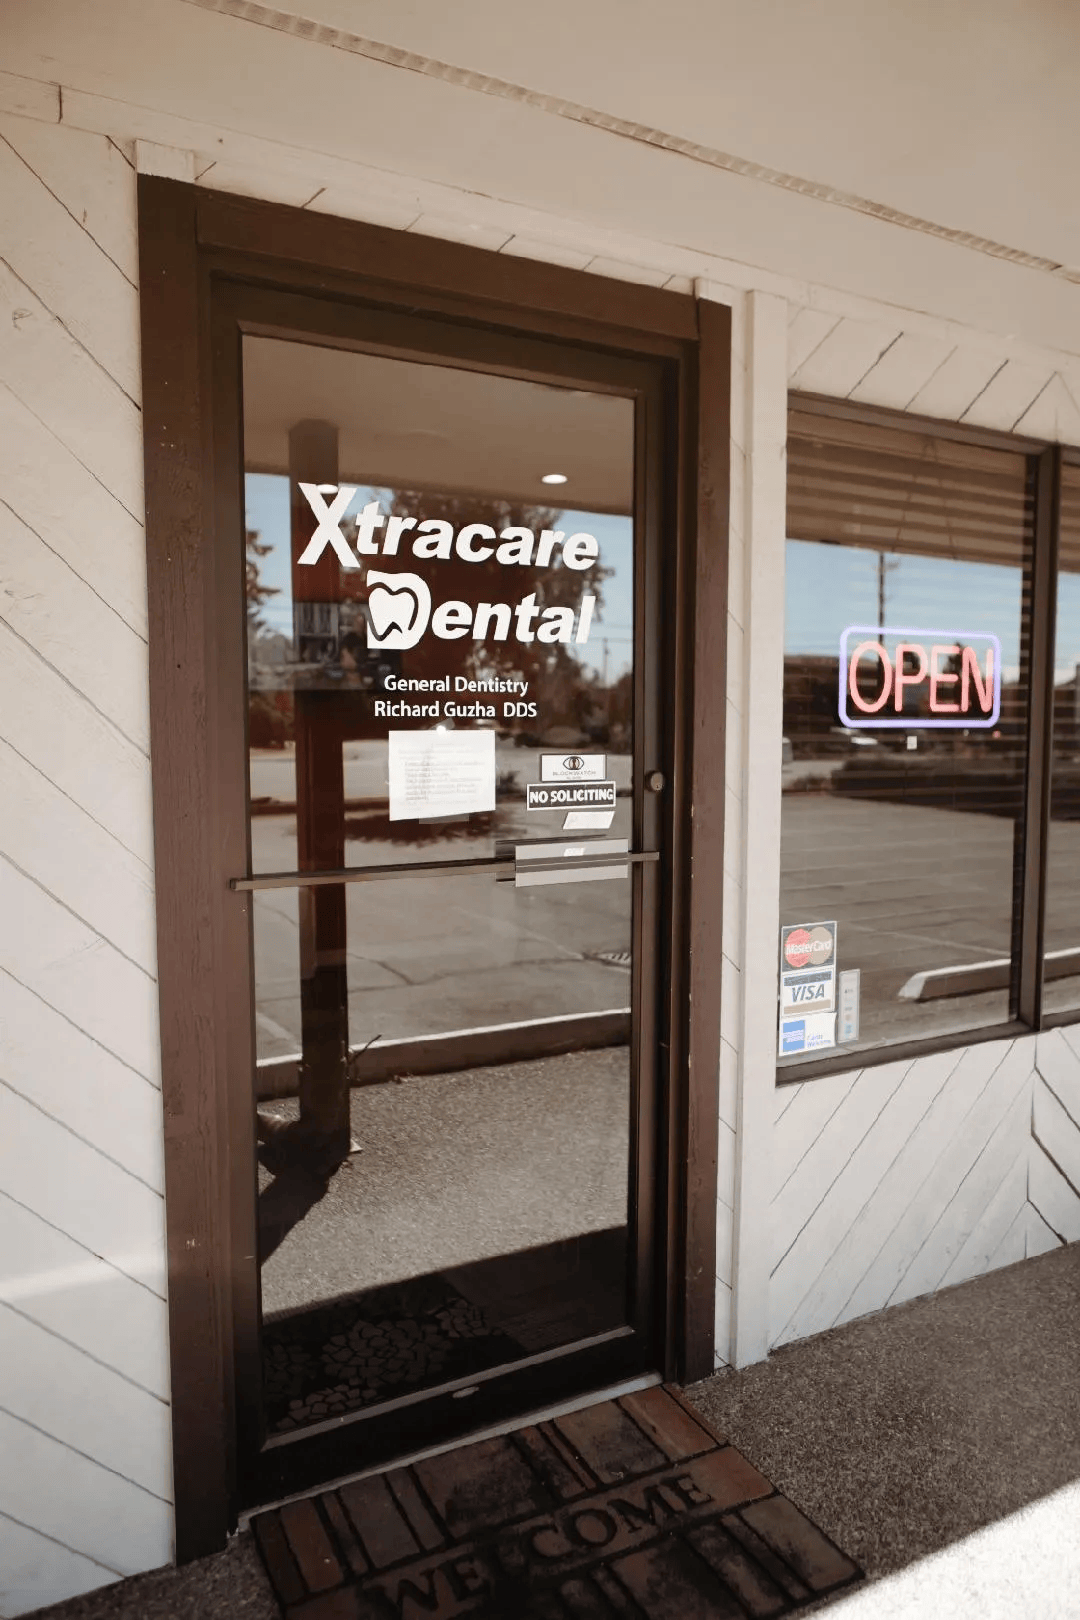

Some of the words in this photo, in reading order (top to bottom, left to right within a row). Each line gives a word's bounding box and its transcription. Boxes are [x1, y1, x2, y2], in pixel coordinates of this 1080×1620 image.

[297, 482, 599, 570] Xtracare
[366, 570, 596, 650] Dental
[384, 675, 450, 693] General
[455, 676, 529, 696] Dentistry
[849, 641, 994, 713] OPEN
[374, 701, 440, 718] Richard
[444, 702, 496, 718] Guzha
[503, 702, 537, 718] DDS
[529, 790, 549, 804] NO
[550, 788, 614, 803] SOLICITING
[791, 983, 825, 1003] VISA
